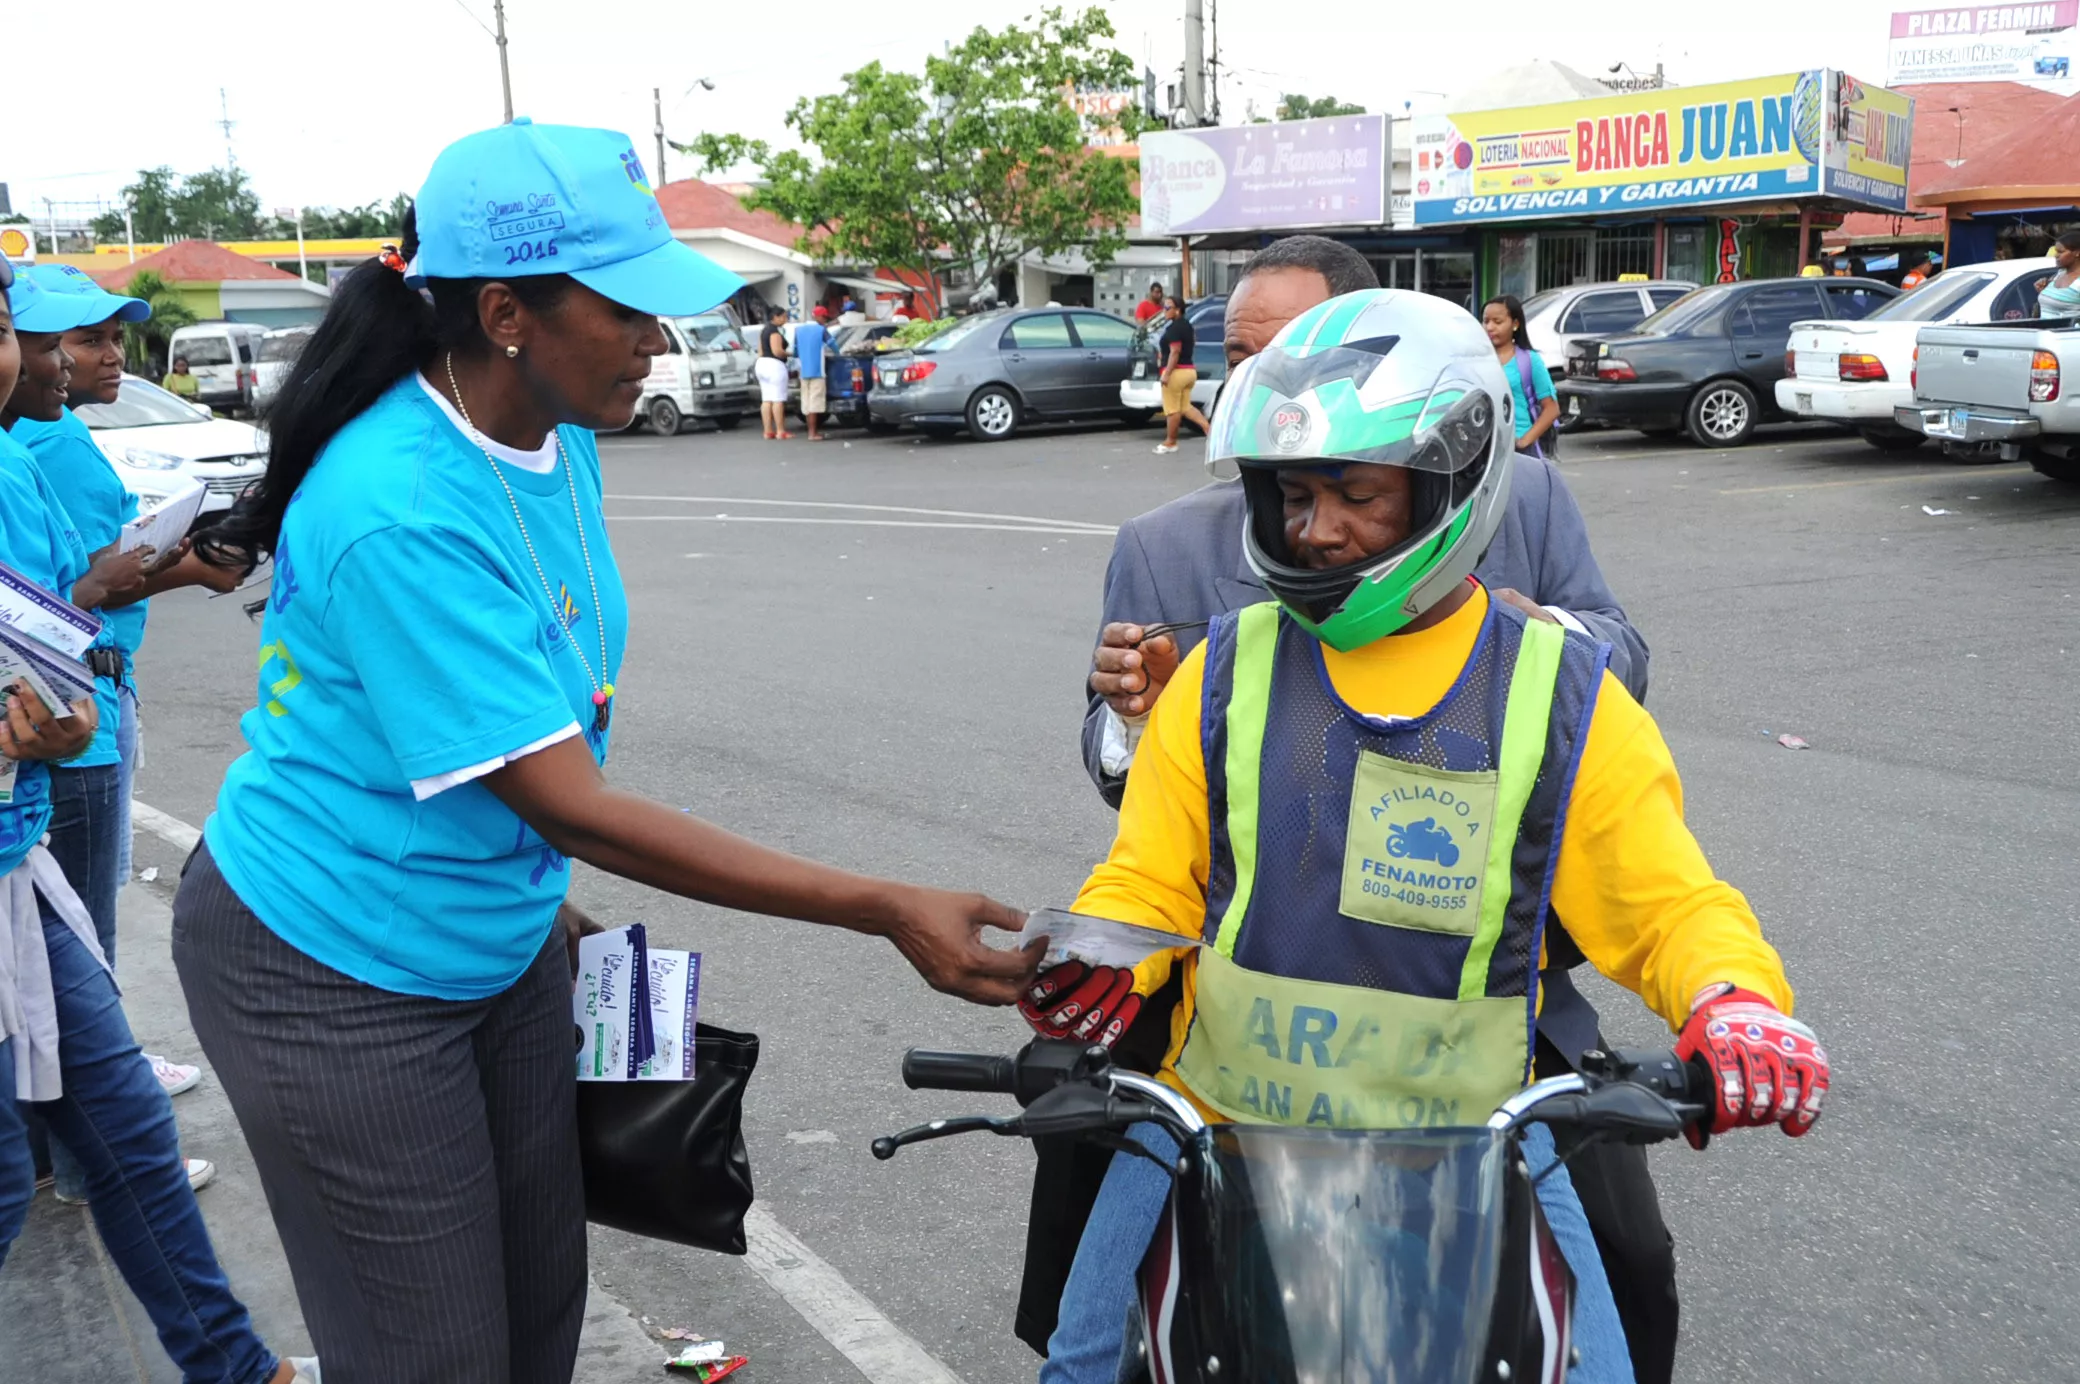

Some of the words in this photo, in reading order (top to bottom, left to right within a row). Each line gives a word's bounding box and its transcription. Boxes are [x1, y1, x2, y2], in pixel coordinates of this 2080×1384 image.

[1908, 11, 1971, 36] PLAZA
[1976, 4, 2057, 34] FERMIN
[1895, 48, 1960, 67] VANESSA
[1576, 112, 1669, 172] BANCA
[1678, 95, 1793, 163] JUAN
[1232, 146, 1265, 176] La
[1271, 142, 1369, 174] Famosa
[1480, 142, 1519, 164] LOTERIA
[1521, 138, 1569, 160] NACIONAL
[1150, 154, 1217, 181] Banca
[1453, 188, 1588, 214] SOLVENCIA
[1598, 187, 1618, 204] Y
[1621, 173, 1758, 201] GARANTIA
[498, 217, 556, 237] SEGURA
[504, 238, 558, 265] 2016
[1370, 785, 1470, 822] AFILIADO
[1466, 822, 1480, 837] A
[1361, 857, 1477, 891] FENAMOTO
[1362, 878, 1467, 910] 809-409-9555
[689, 957, 697, 990] SEMANA
[686, 993, 694, 1016] SANTA
